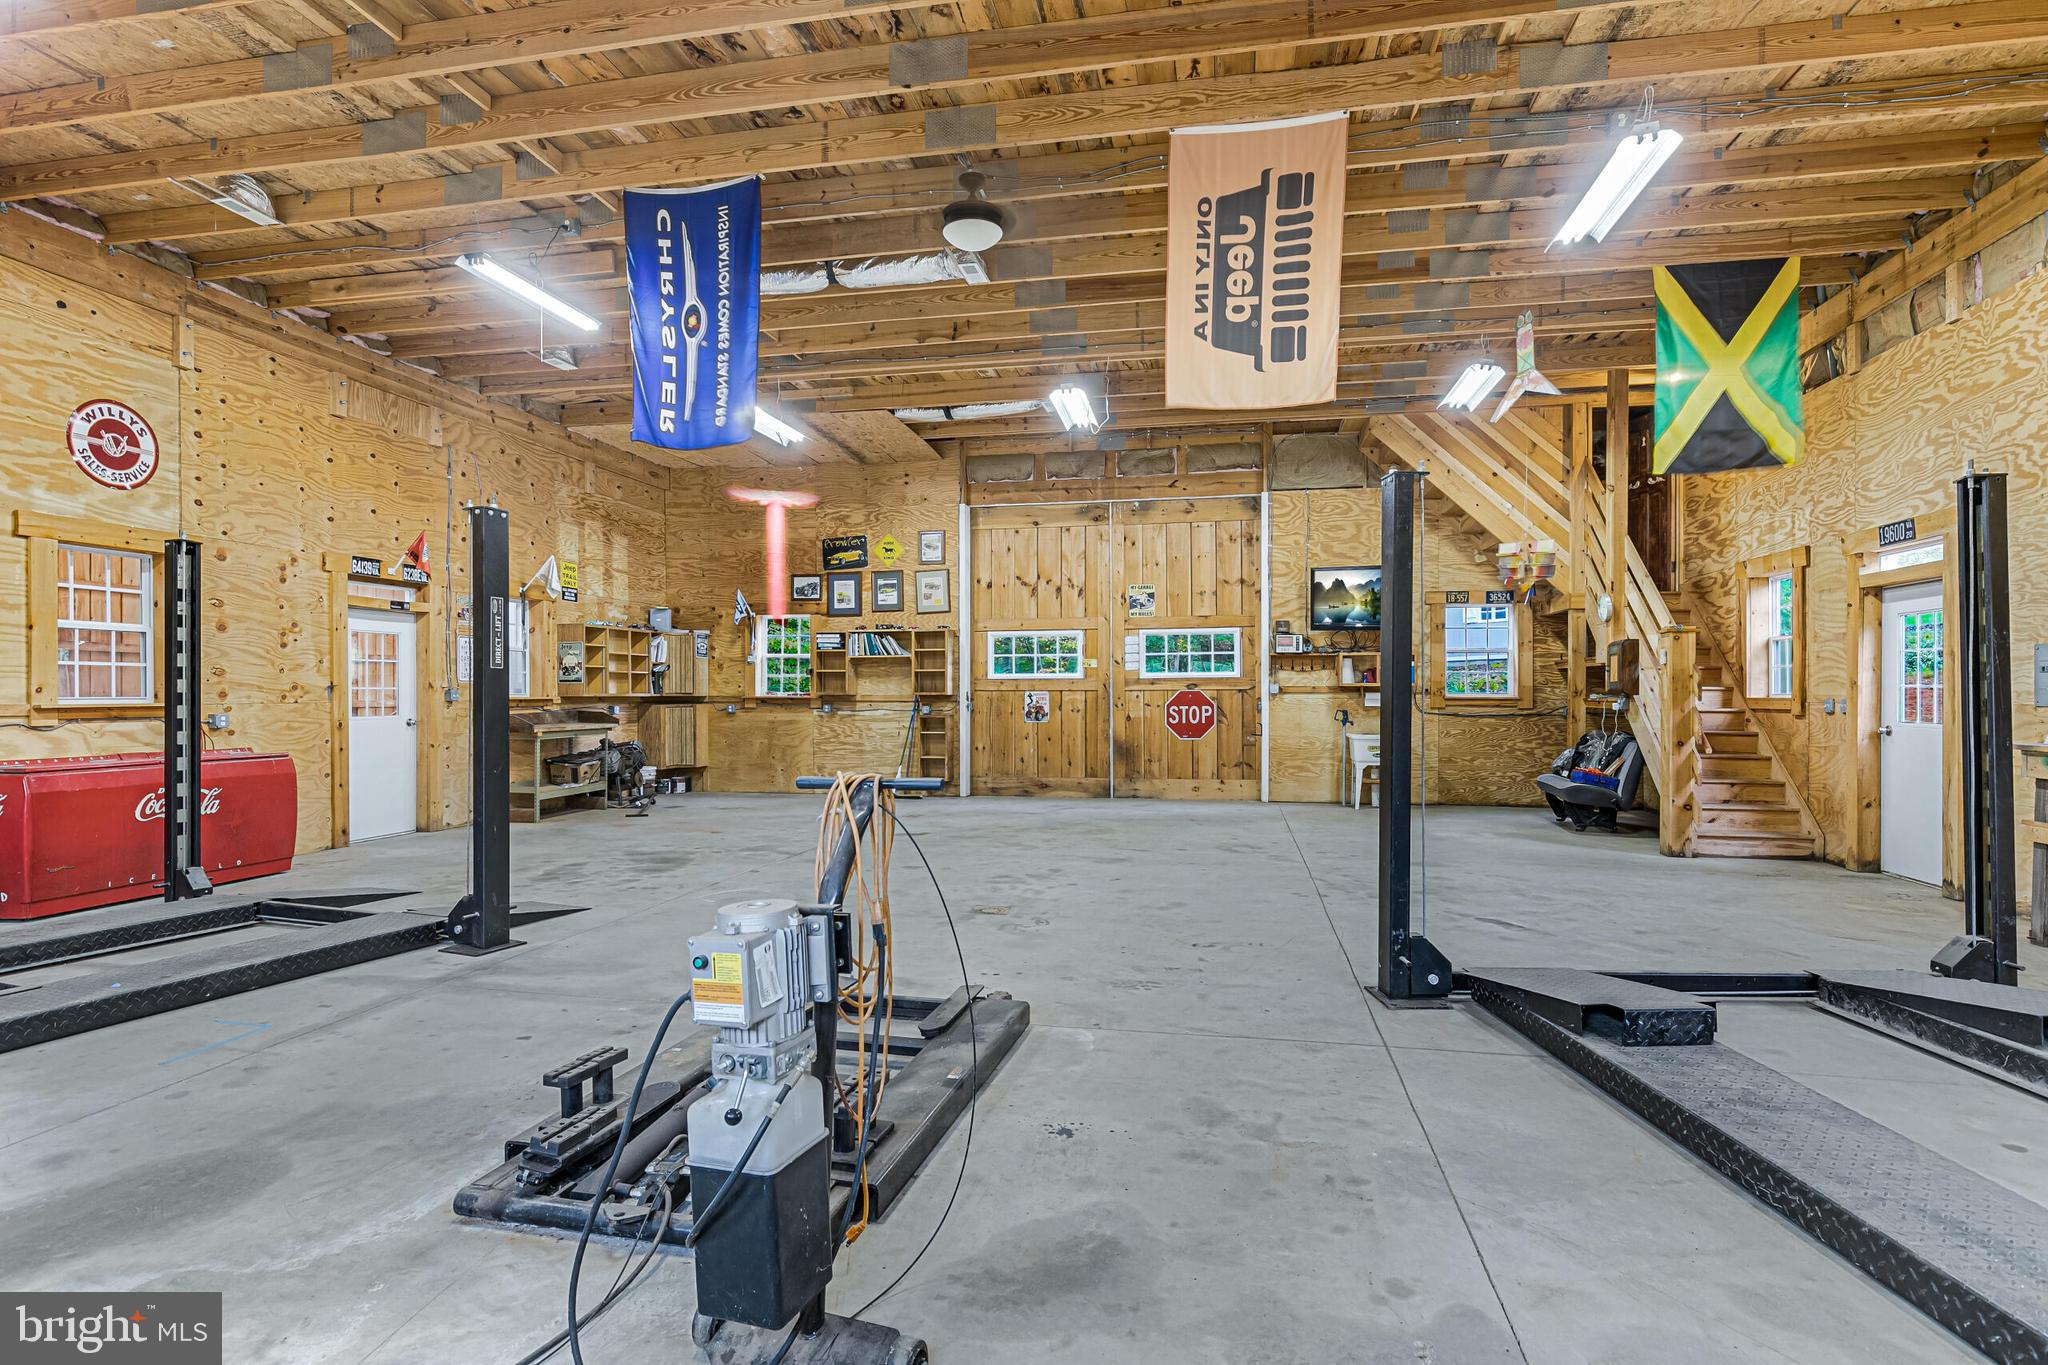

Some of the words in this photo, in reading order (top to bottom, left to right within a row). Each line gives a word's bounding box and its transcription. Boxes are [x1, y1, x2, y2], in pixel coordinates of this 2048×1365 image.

[80, 406, 148, 438] WILLYS
[1880, 522, 1905, 545] 19600
[352, 559, 372, 575] 64139
[1168, 705, 1213, 724] STOP
